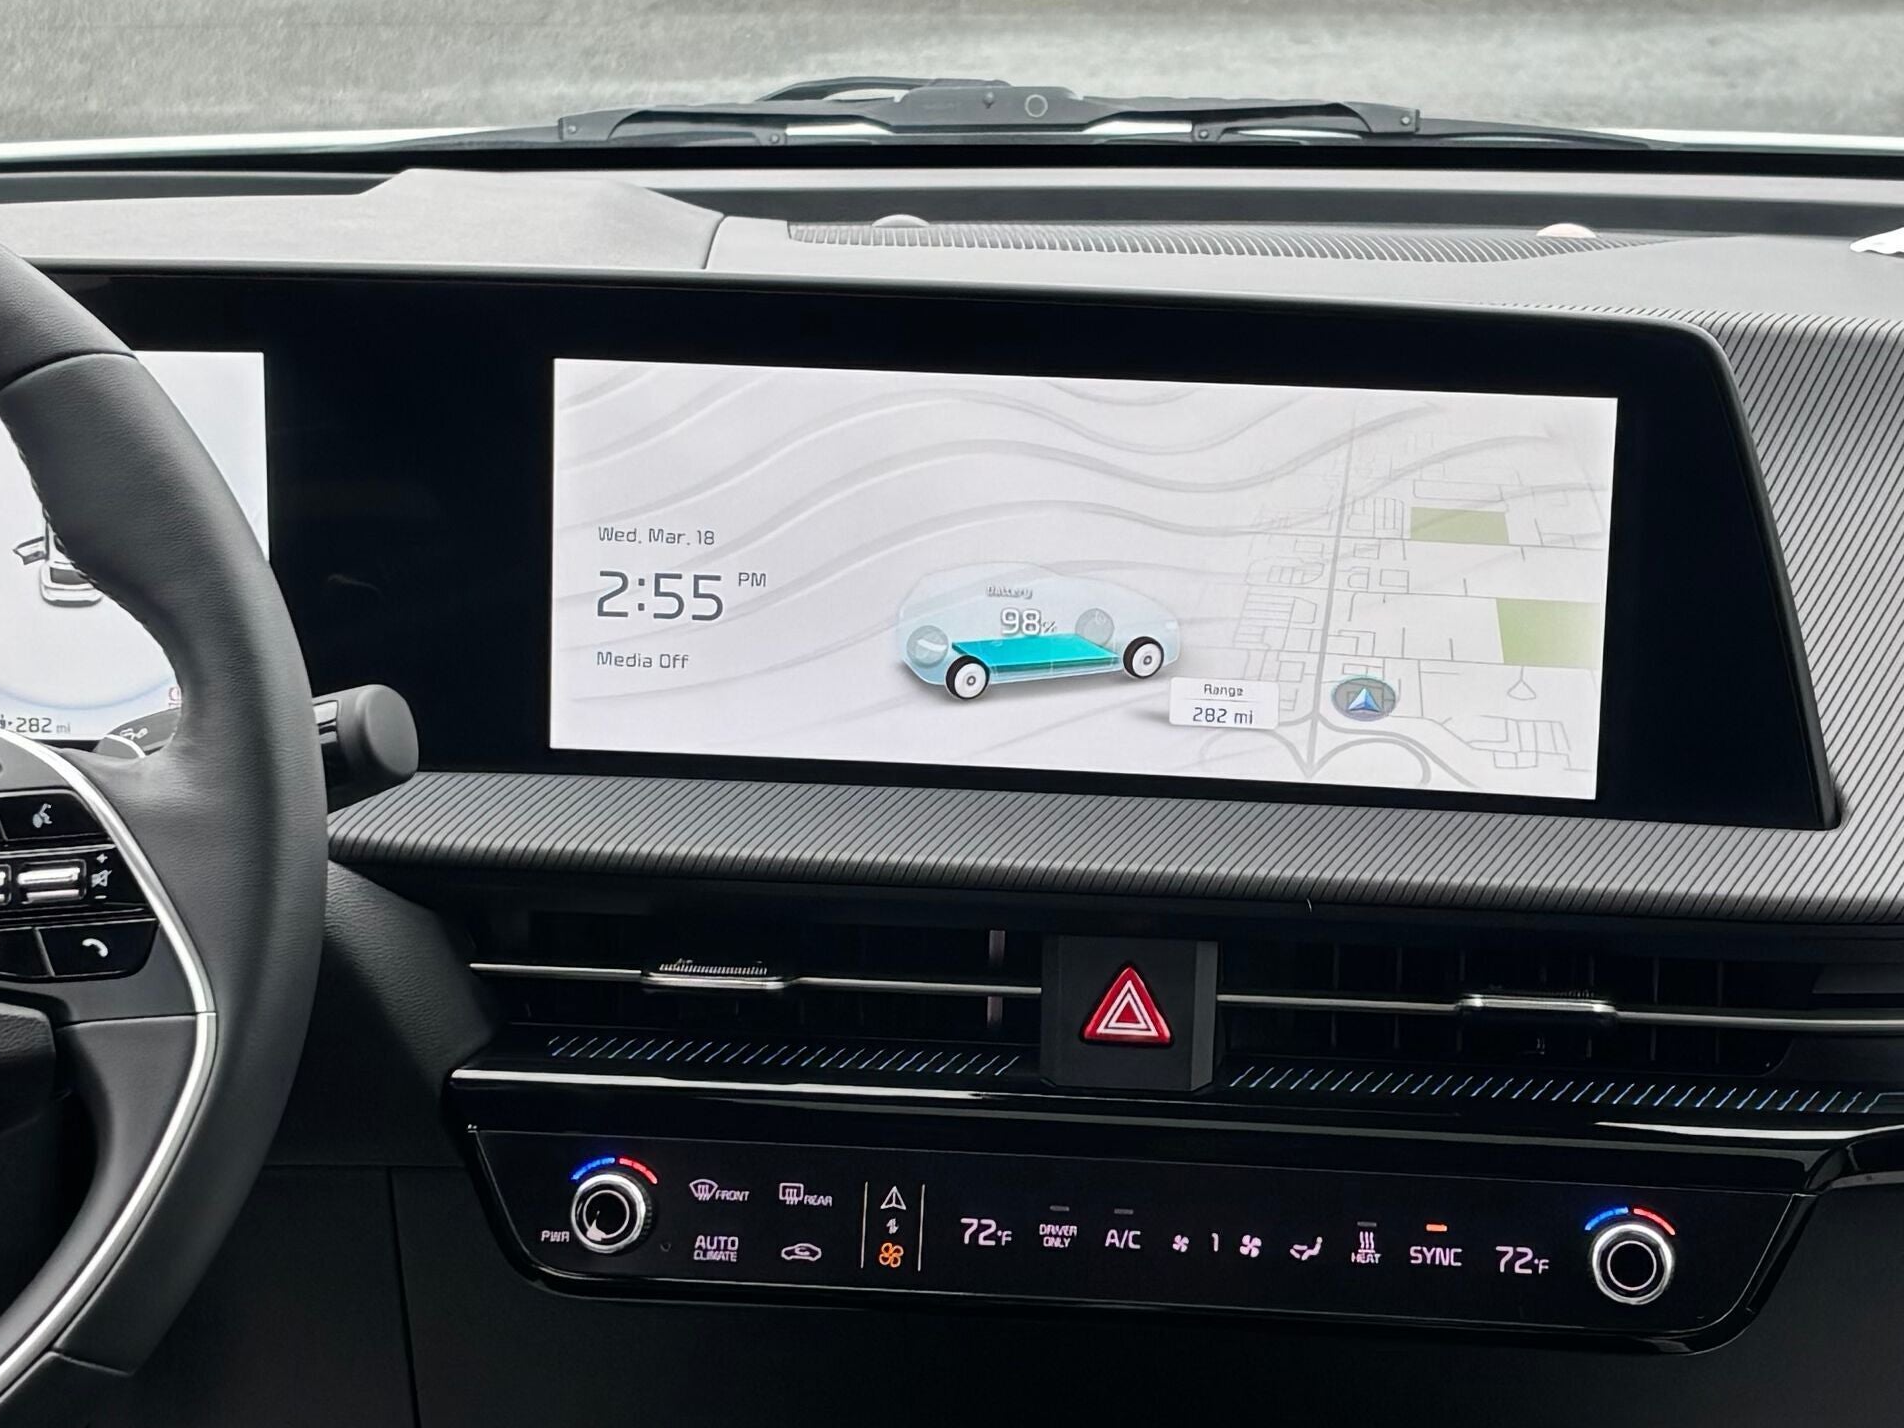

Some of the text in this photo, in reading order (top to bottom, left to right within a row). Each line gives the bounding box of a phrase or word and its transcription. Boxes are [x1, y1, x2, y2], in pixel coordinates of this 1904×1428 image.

[598, 526, 715, 546] Wed. Mar. 18
[597, 570, 767, 622] 2:55 PM
[596, 651, 689, 669] Media Off
[1203, 683, 1245, 698] Range
[1192, 707, 1253, 725] 282 mi
[15, 716, 71, 734] 282 mi
[715, 1189, 750, 1202] FRONT
[803, 1194, 833, 1207] REAR
[541, 1230, 570, 1243] PWR
[1038, 1224, 1078, 1237] DRIVER
[694, 1235, 739, 1251] AUTO
[1043, 1236, 1071, 1249] ONLY
[1104, 1228, 1141, 1250] A/C
[693, 1250, 738, 1262] CLIMATE
[1350, 1252, 1381, 1266] HEAT
[1409, 1245, 1463, 1267] SYNC
